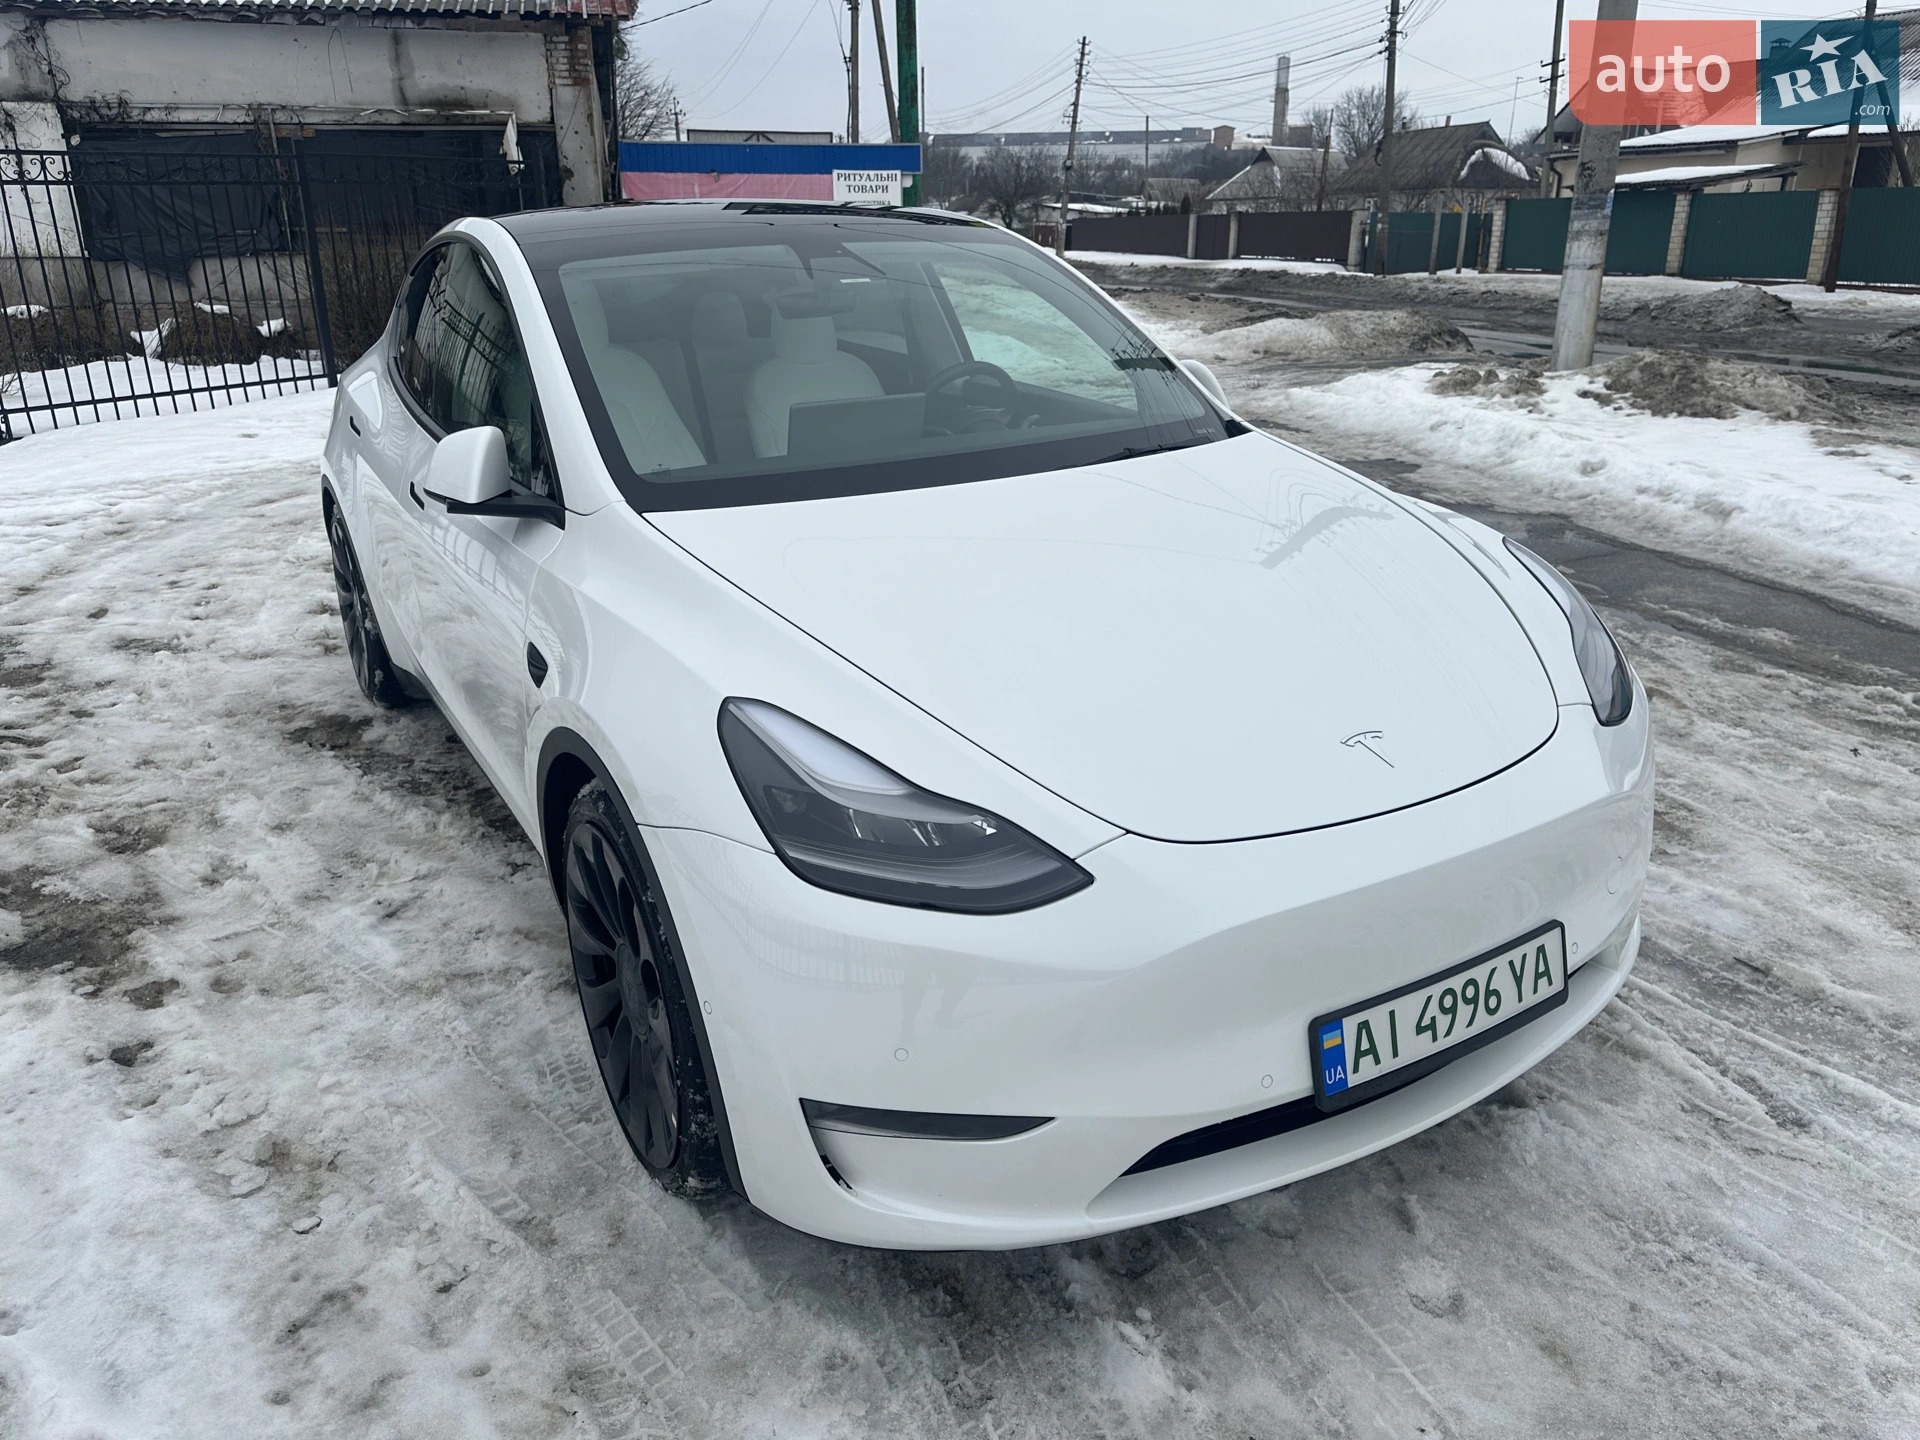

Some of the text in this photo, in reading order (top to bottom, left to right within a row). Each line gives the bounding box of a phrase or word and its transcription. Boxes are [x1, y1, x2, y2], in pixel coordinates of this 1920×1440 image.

[837, 172, 898, 182] РИТУАЛЬНІ
[846, 184, 889, 193] ТОВАРИ
[1352, 943, 1553, 1074] AI 4996 YA
[1325, 1065, 1345, 1084] UA
